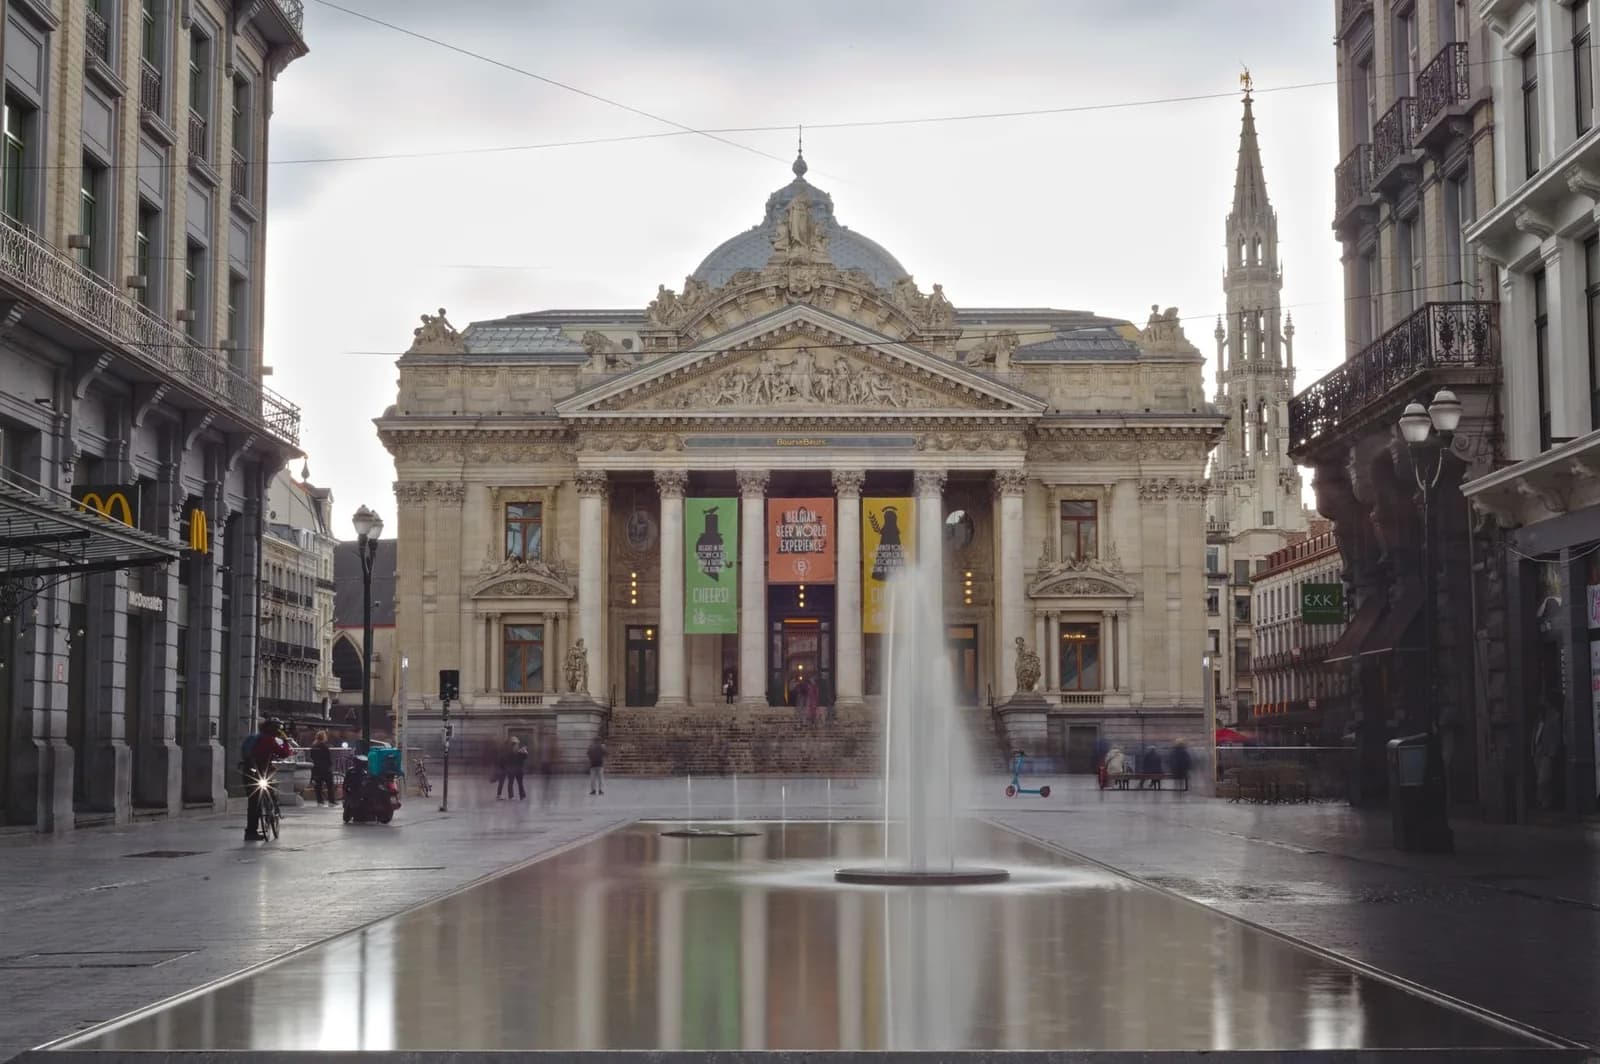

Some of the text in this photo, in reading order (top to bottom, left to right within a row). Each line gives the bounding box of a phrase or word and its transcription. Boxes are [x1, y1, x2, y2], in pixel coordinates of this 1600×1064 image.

[785, 510, 817, 523] BELGIAN
[776, 524, 827, 537] BEER WORLD
[780, 539, 825, 552] EXPERIENCE
[129, 591, 163, 611] McDonald's
